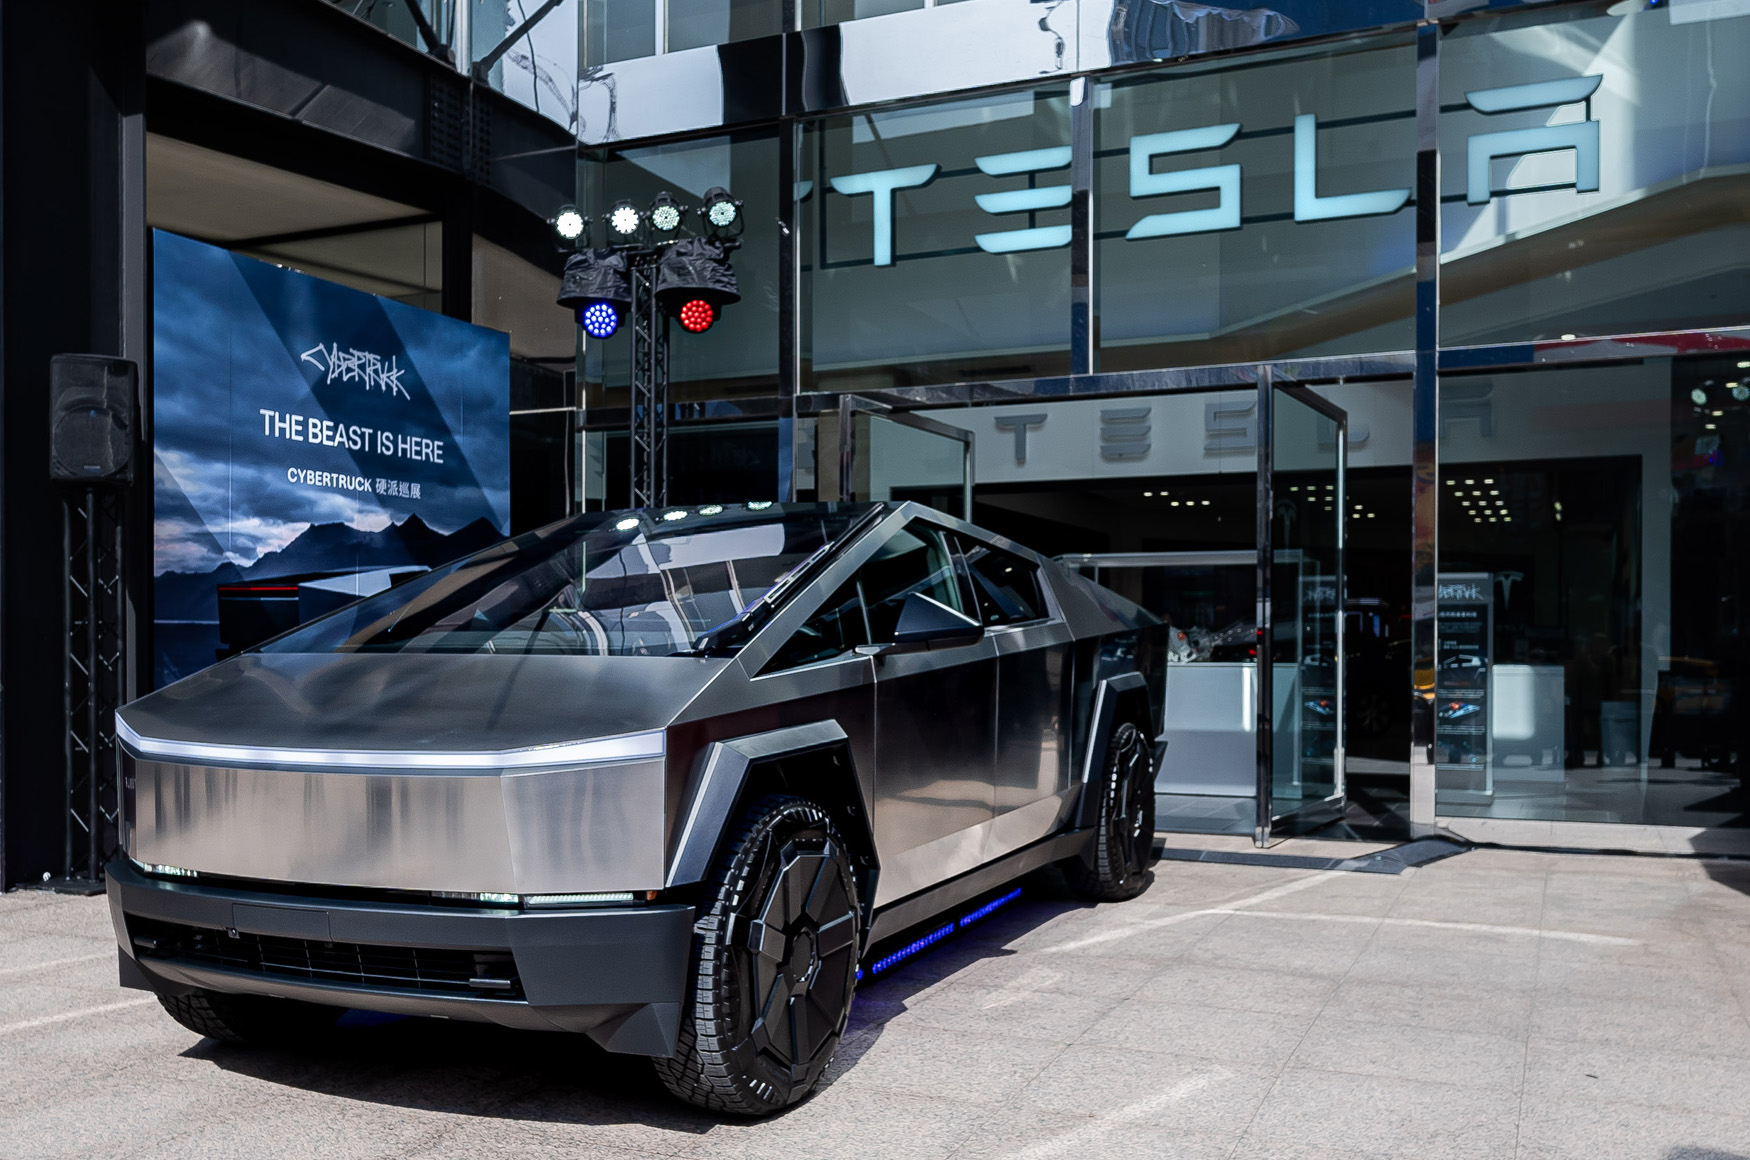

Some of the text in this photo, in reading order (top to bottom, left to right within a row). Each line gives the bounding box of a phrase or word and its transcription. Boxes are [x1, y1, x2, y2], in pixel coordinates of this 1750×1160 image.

[831, 75, 1603, 266] TESLA
[259, 408, 444, 464] THE BEAST IS HERE
[287, 467, 421, 500] CYBERTRUCK 硬派巡展
